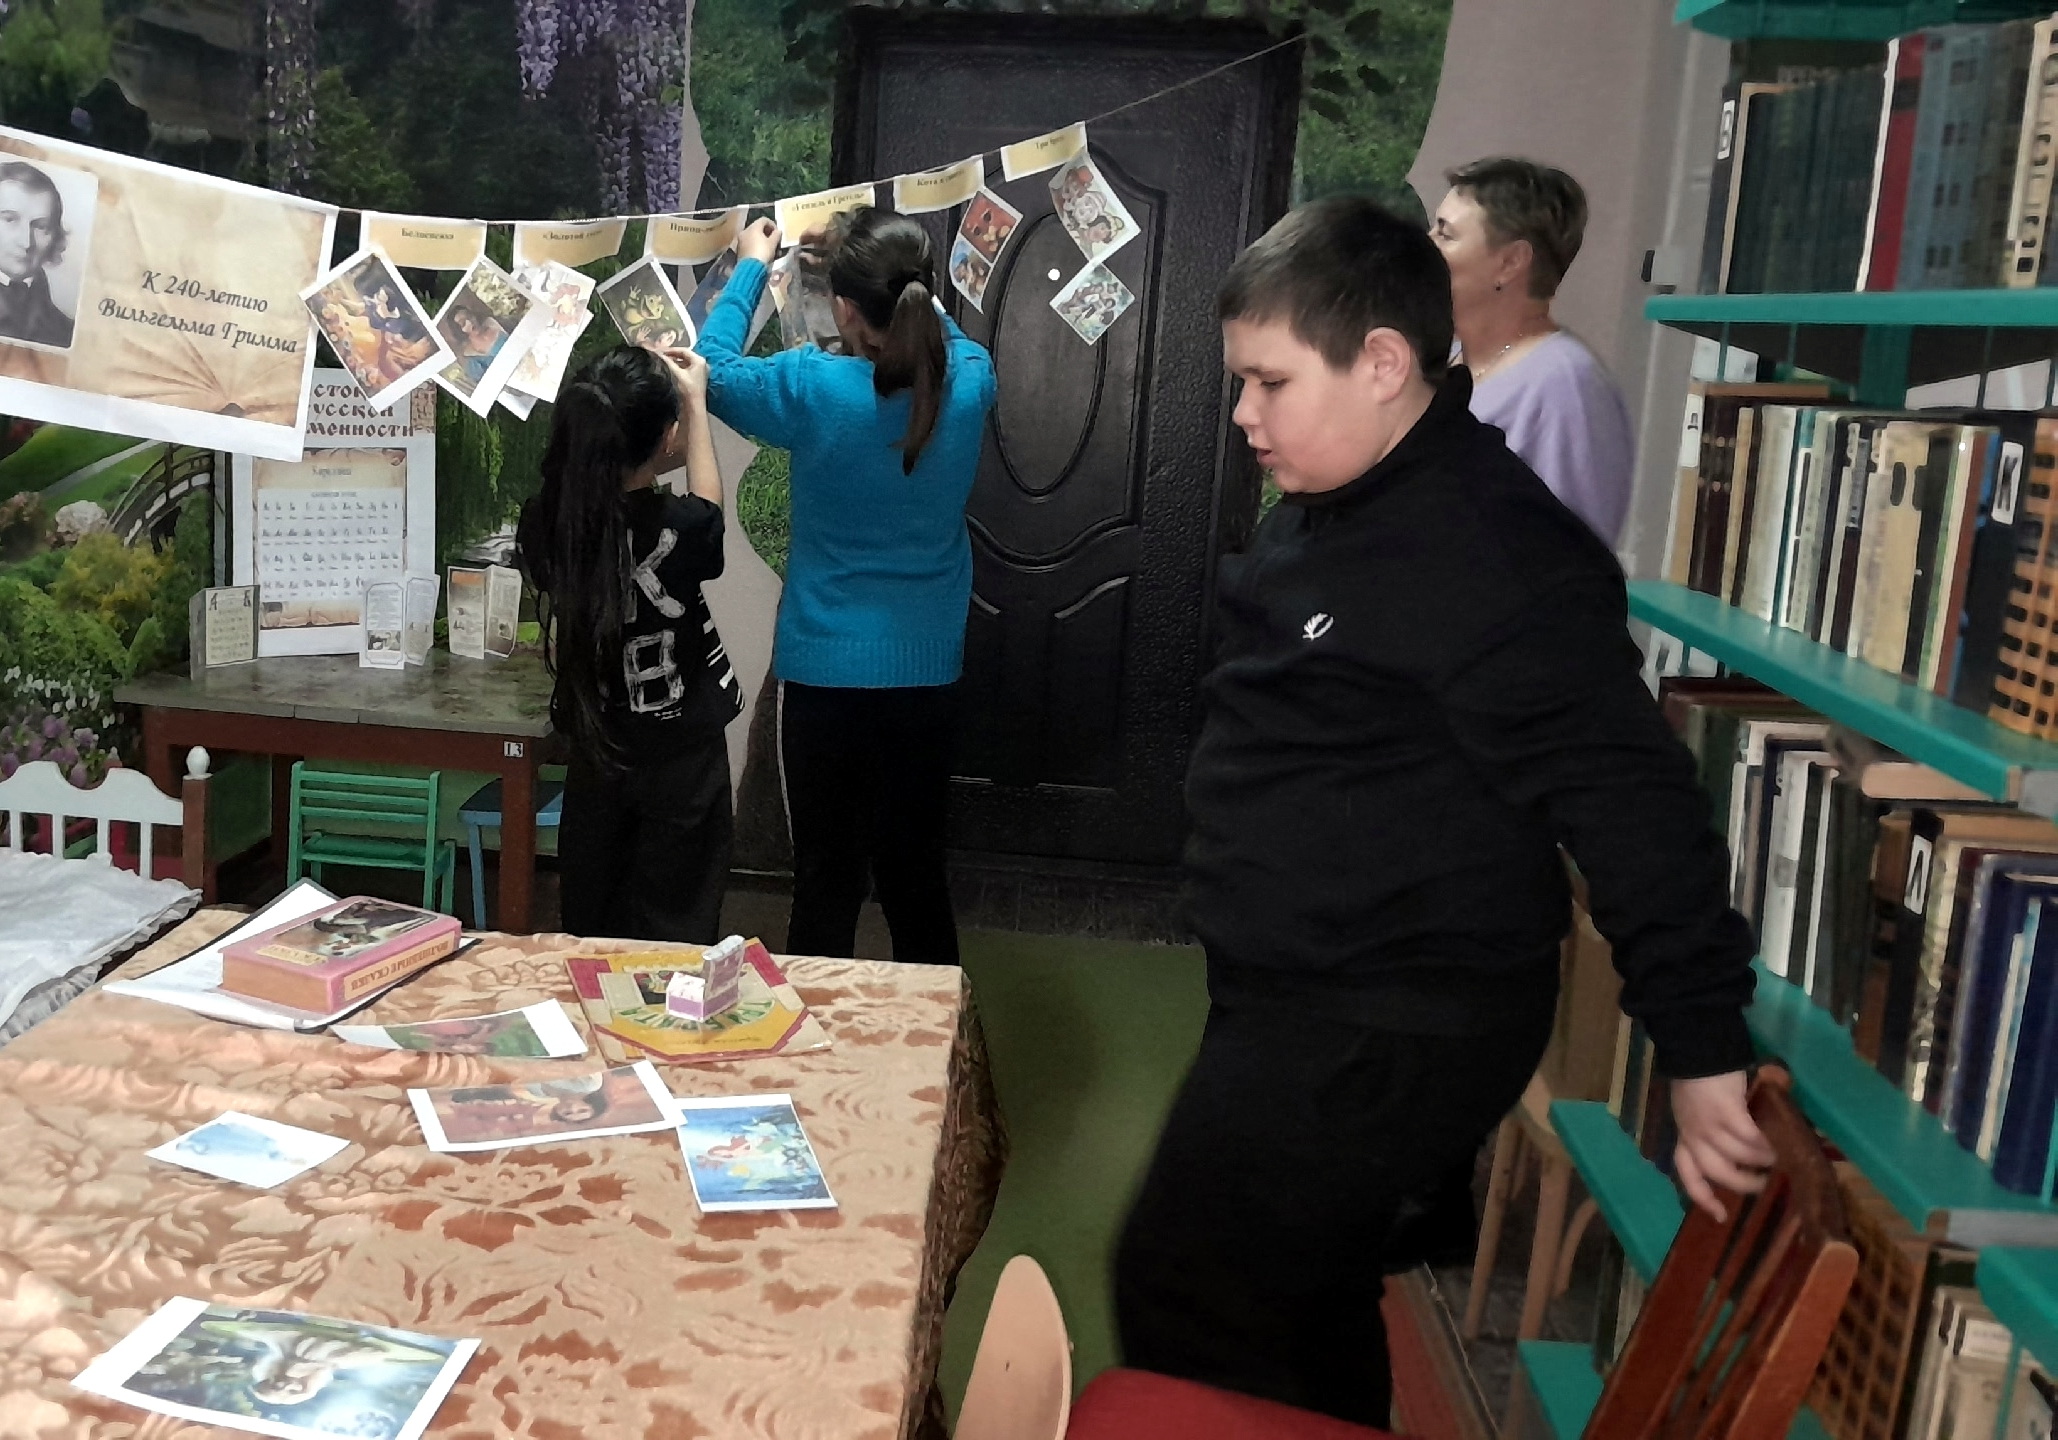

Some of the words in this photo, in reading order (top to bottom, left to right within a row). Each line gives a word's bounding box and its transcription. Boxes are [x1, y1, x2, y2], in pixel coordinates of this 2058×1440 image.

[141, 269, 162, 295] К
[163, 274, 268, 314] 240-летию
[97, 297, 216, 338] Вильгельма
[221, 321, 298, 354] Гримма
